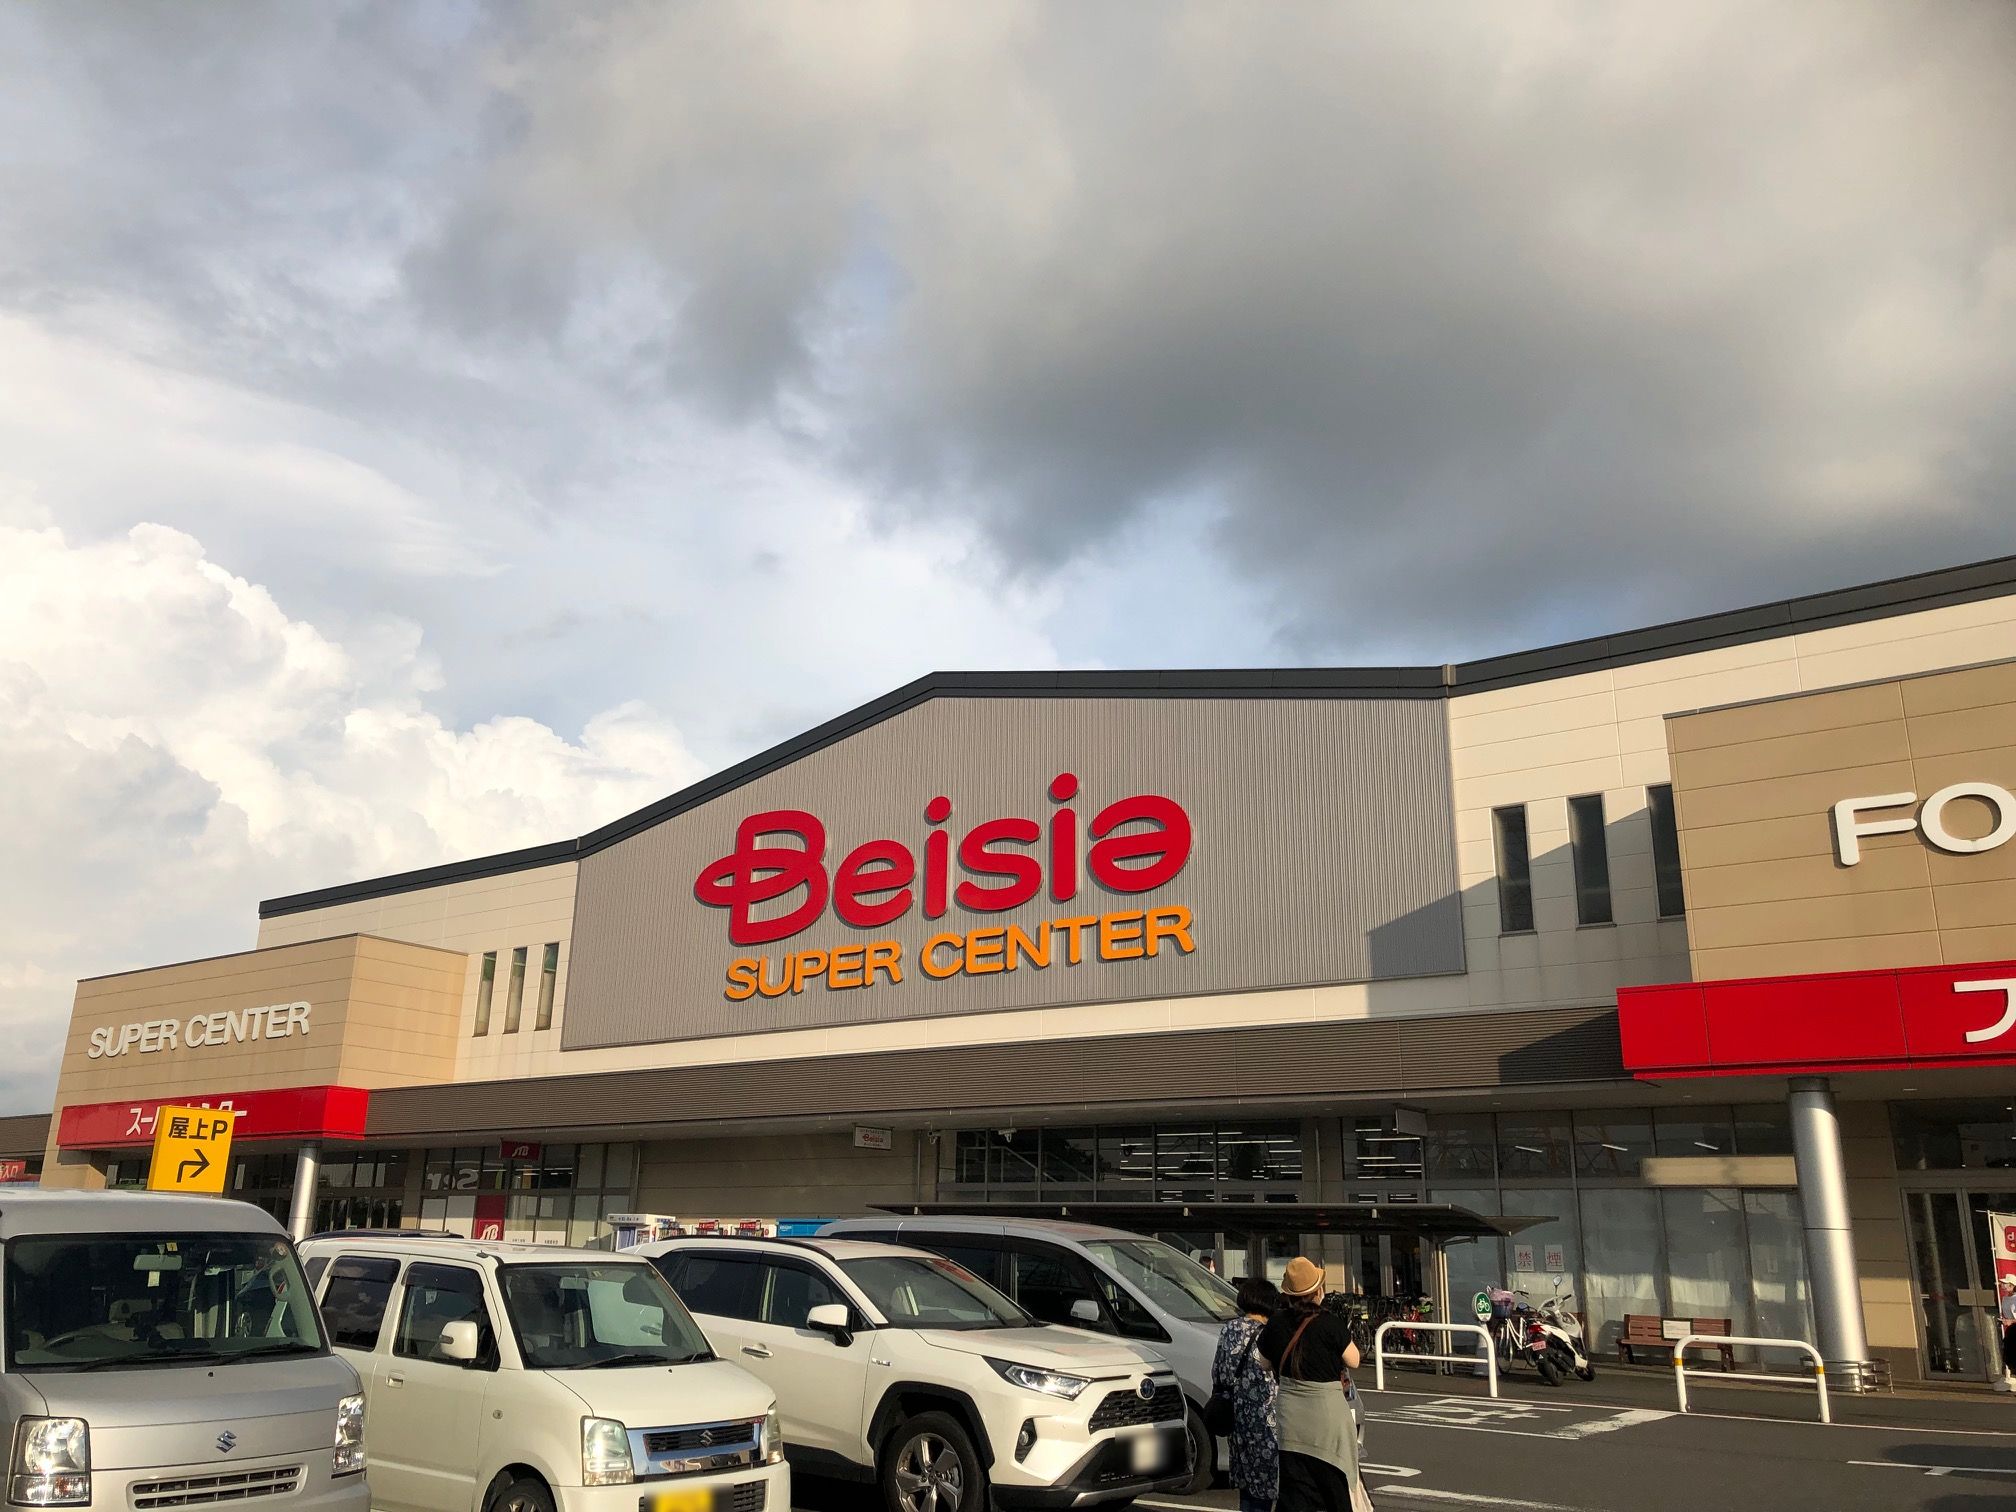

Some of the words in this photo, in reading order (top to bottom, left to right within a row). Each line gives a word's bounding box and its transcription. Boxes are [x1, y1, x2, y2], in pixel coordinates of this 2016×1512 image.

[694, 773, 1193, 945] Beisia
[1834, 782, 2016, 866] FO
[724, 940, 903, 1000] SUPER
[920, 904, 1196, 980] CENTER
[88, 1018, 181, 1059] SUPER
[184, 1001, 312, 1048] CENTER
[168, 1116, 228, 1141] 屋上P
